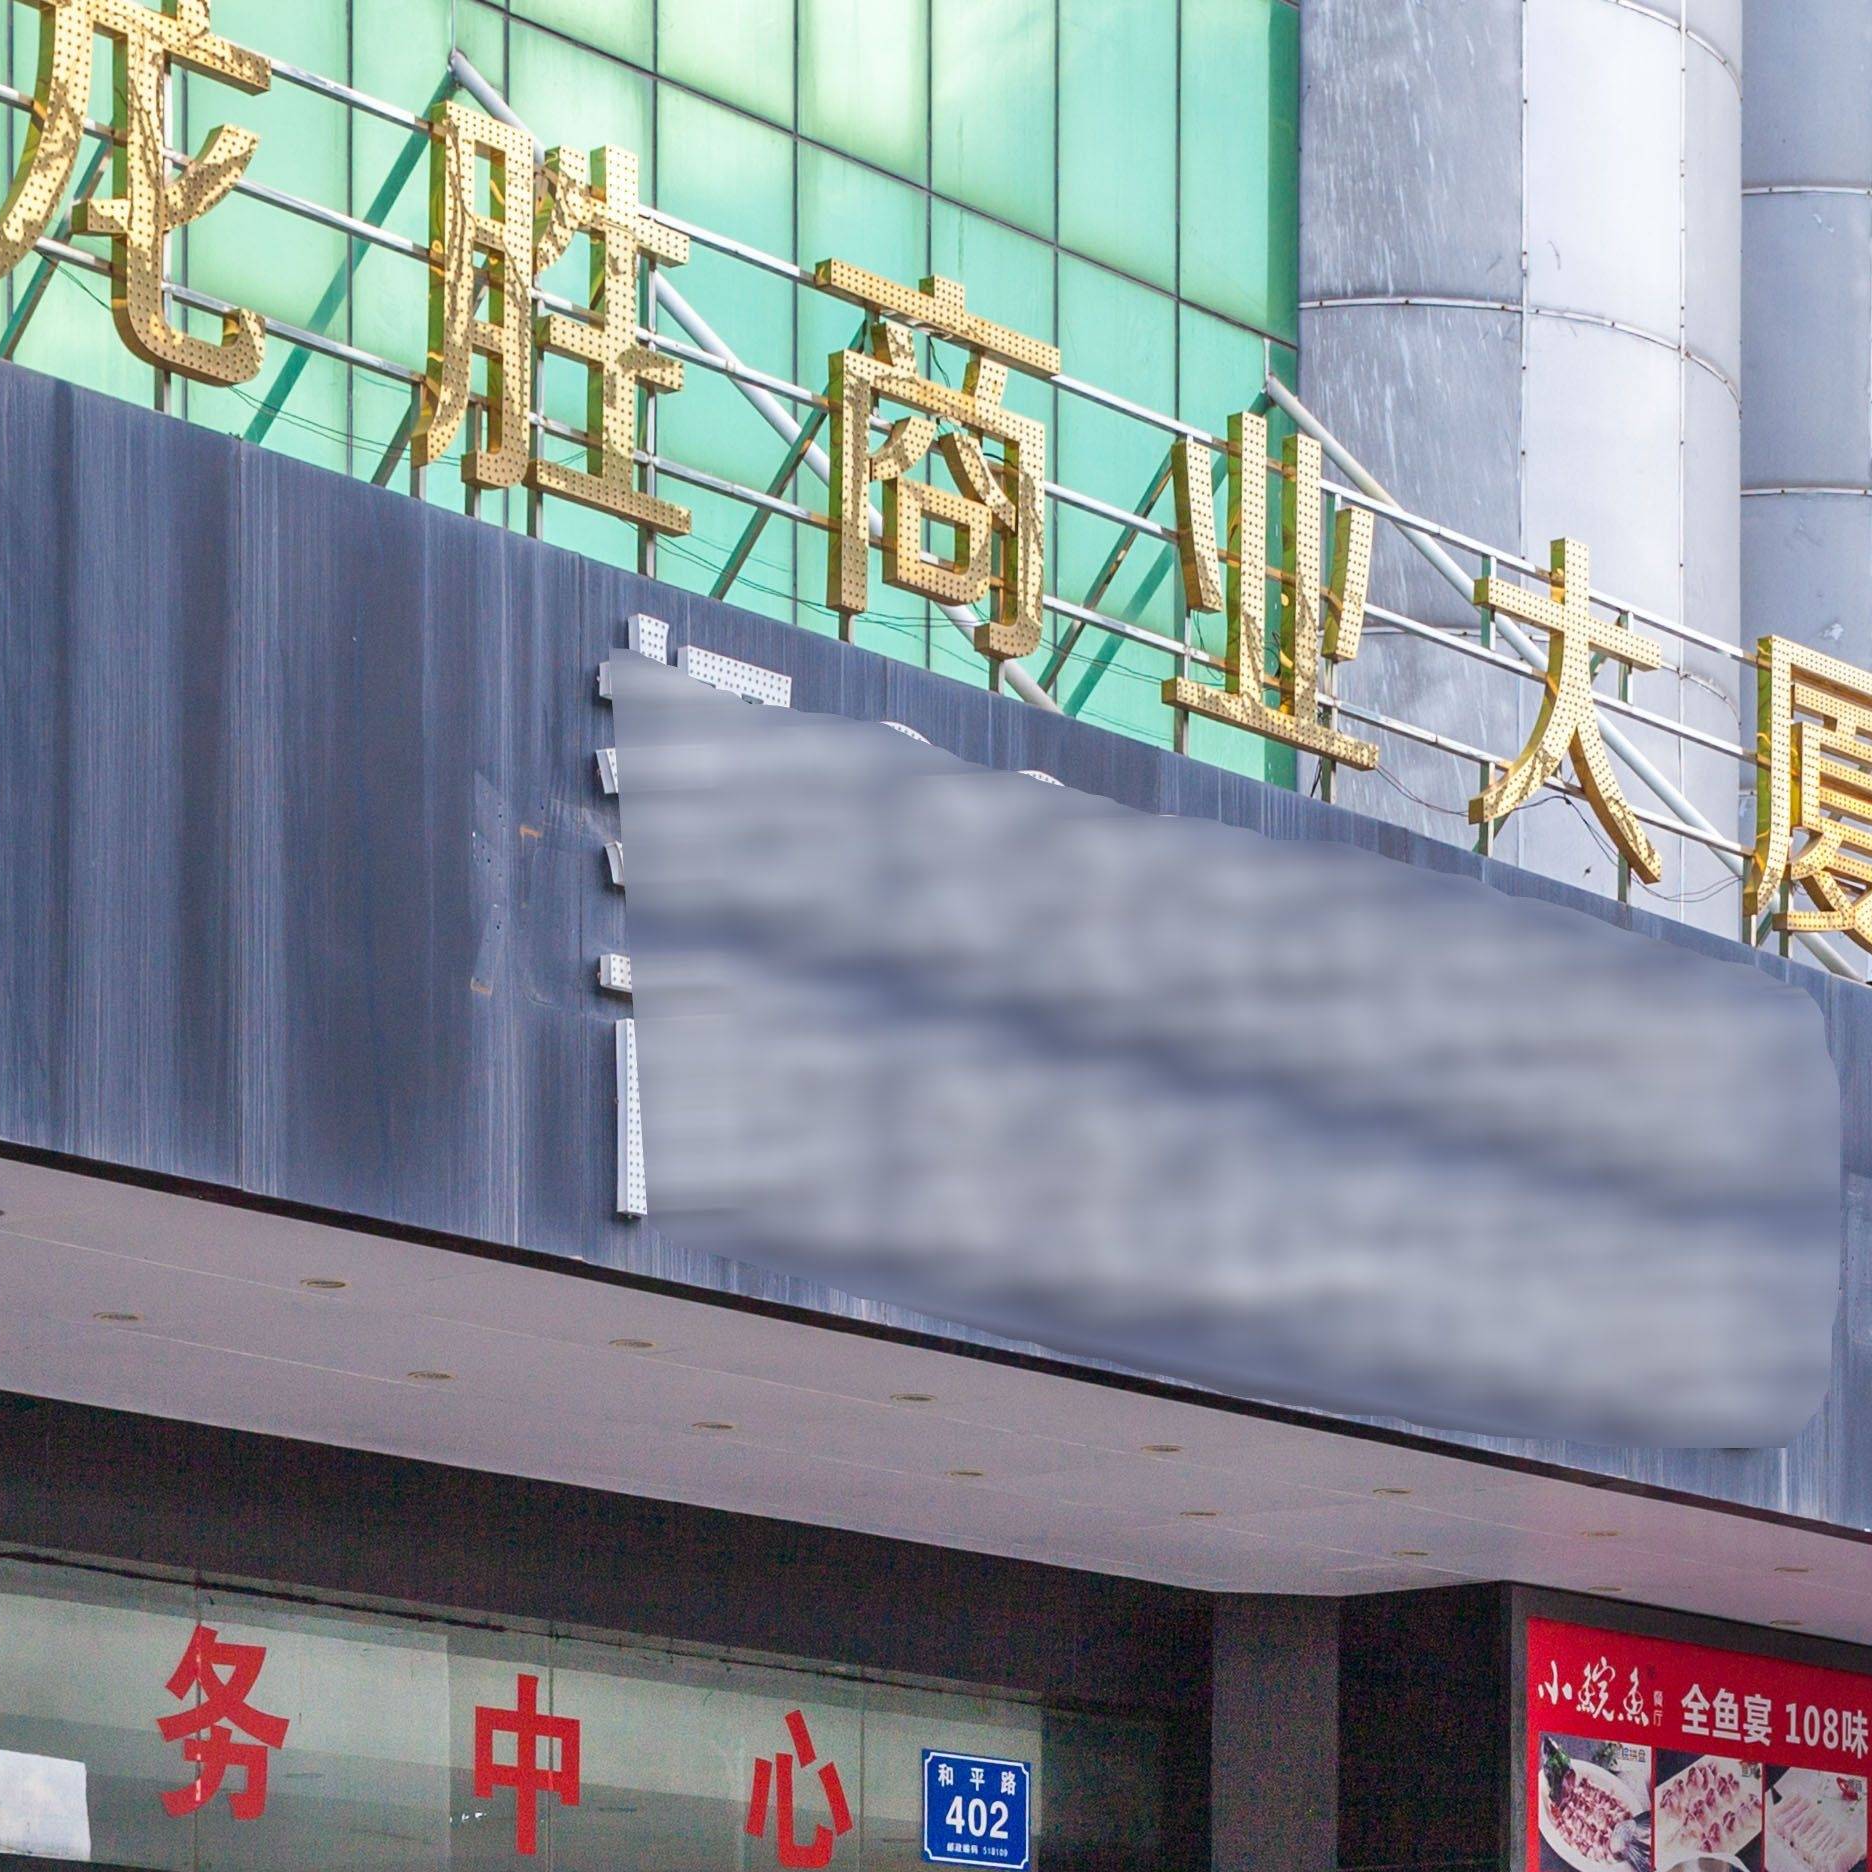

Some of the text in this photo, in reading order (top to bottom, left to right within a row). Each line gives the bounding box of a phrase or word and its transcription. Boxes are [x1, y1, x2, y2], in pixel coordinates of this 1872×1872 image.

[1681, 1684, 1869, 1760] 全鱼宴 108味
[938, 1763, 1016, 1796] 和平路
[945, 1795, 1009, 1839] 402
